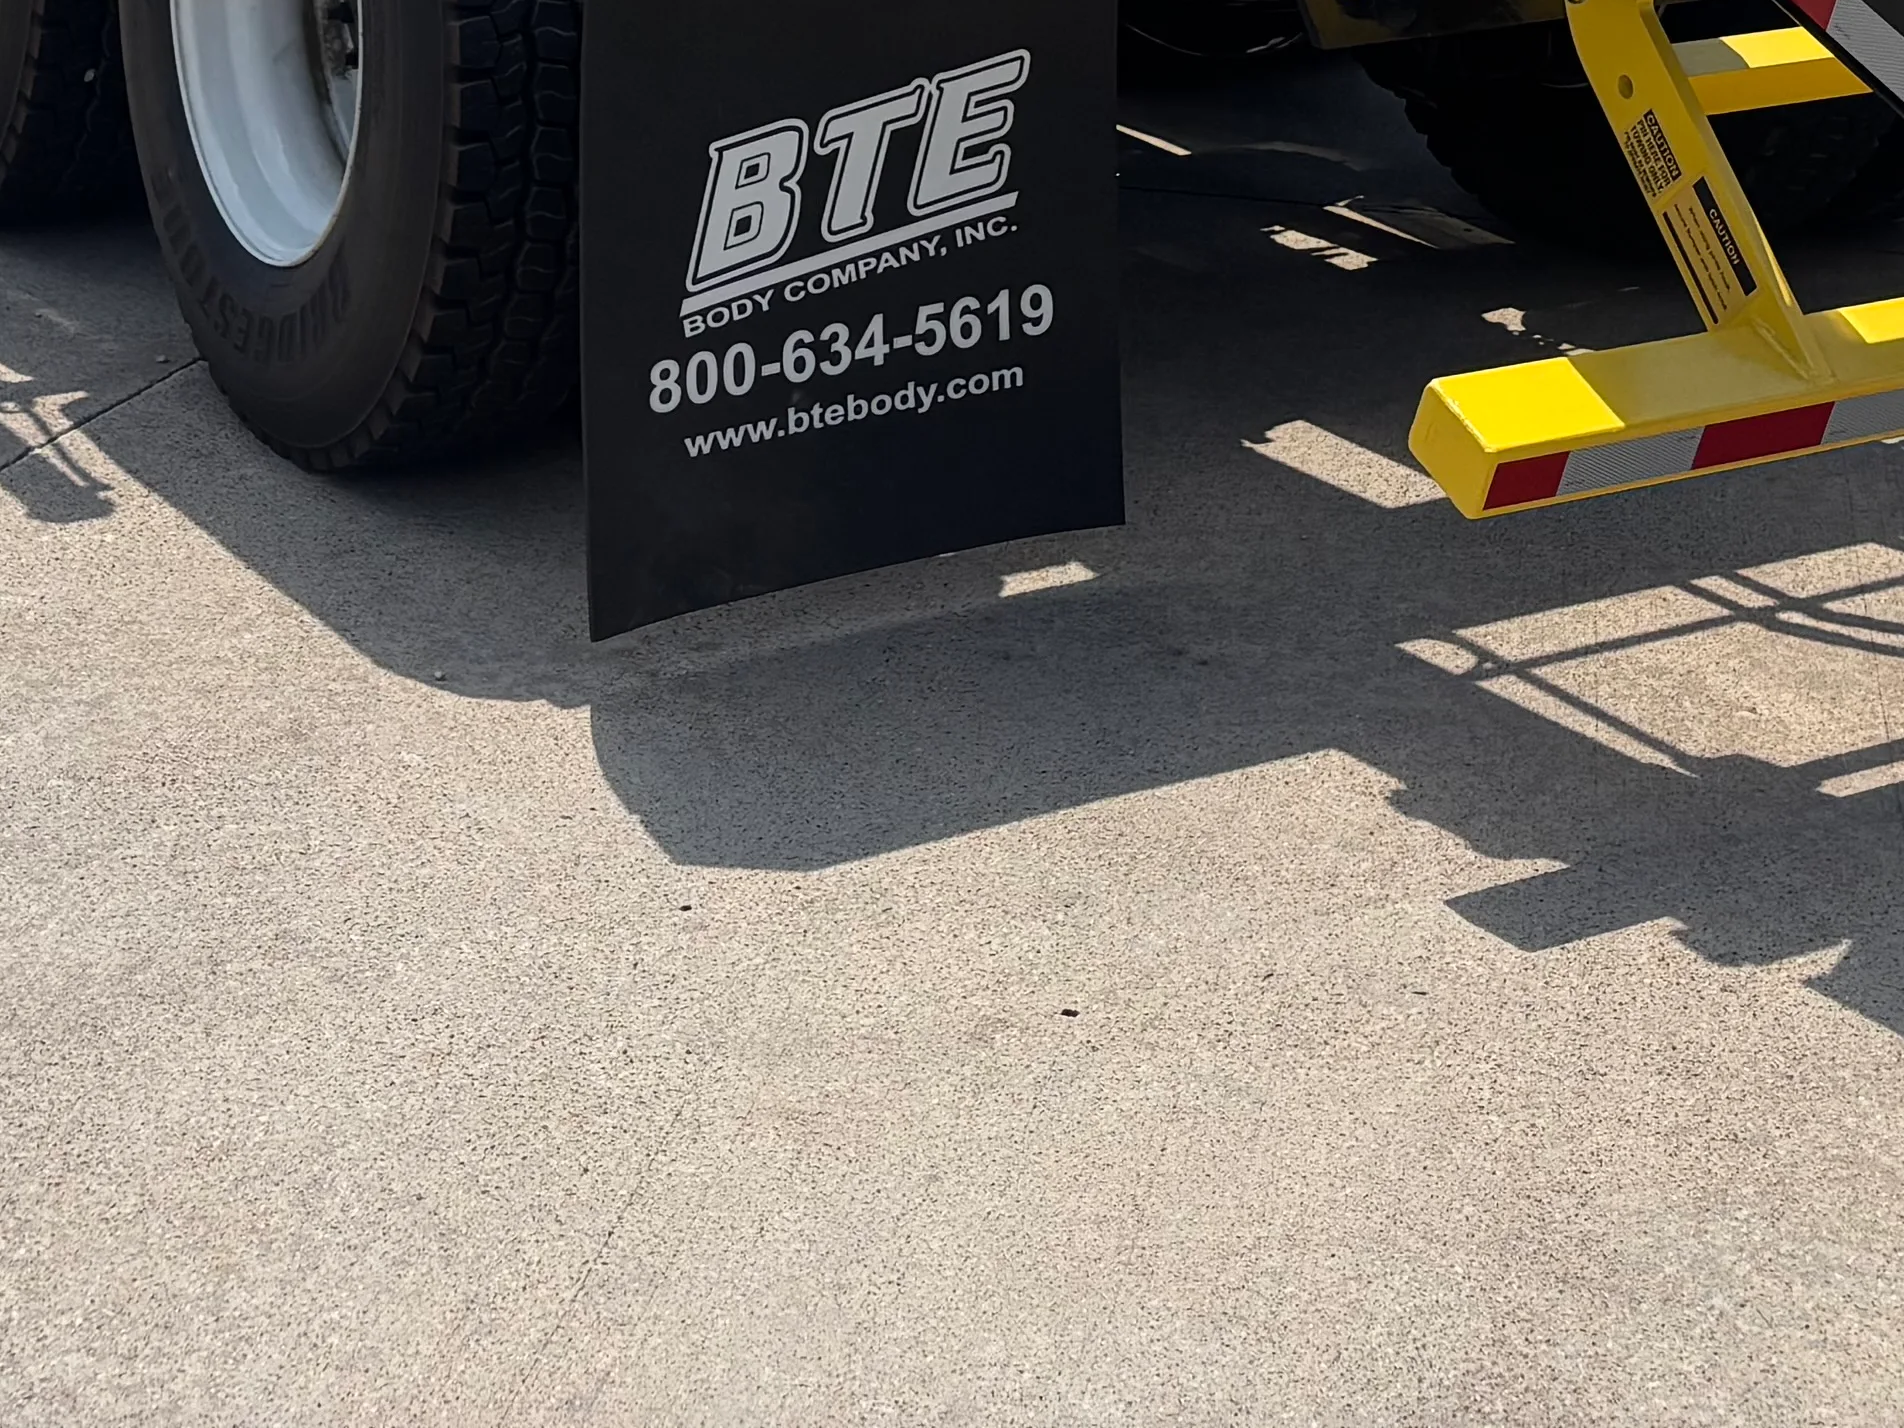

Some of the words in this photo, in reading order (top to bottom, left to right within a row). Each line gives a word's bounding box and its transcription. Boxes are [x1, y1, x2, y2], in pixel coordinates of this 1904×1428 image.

[685, 48, 1032, 293] BTE
[1646, 114, 1680, 177] CAUTION
[682, 289, 783, 339] BODY
[784, 235, 949, 304] COMPANY,
[955, 214, 1019, 248] INC.
[1708, 208, 1740, 265] CAUTION
[648, 283, 1055, 414] 800-634-5619
[684, 365, 1025, 458] www.btebody.com
